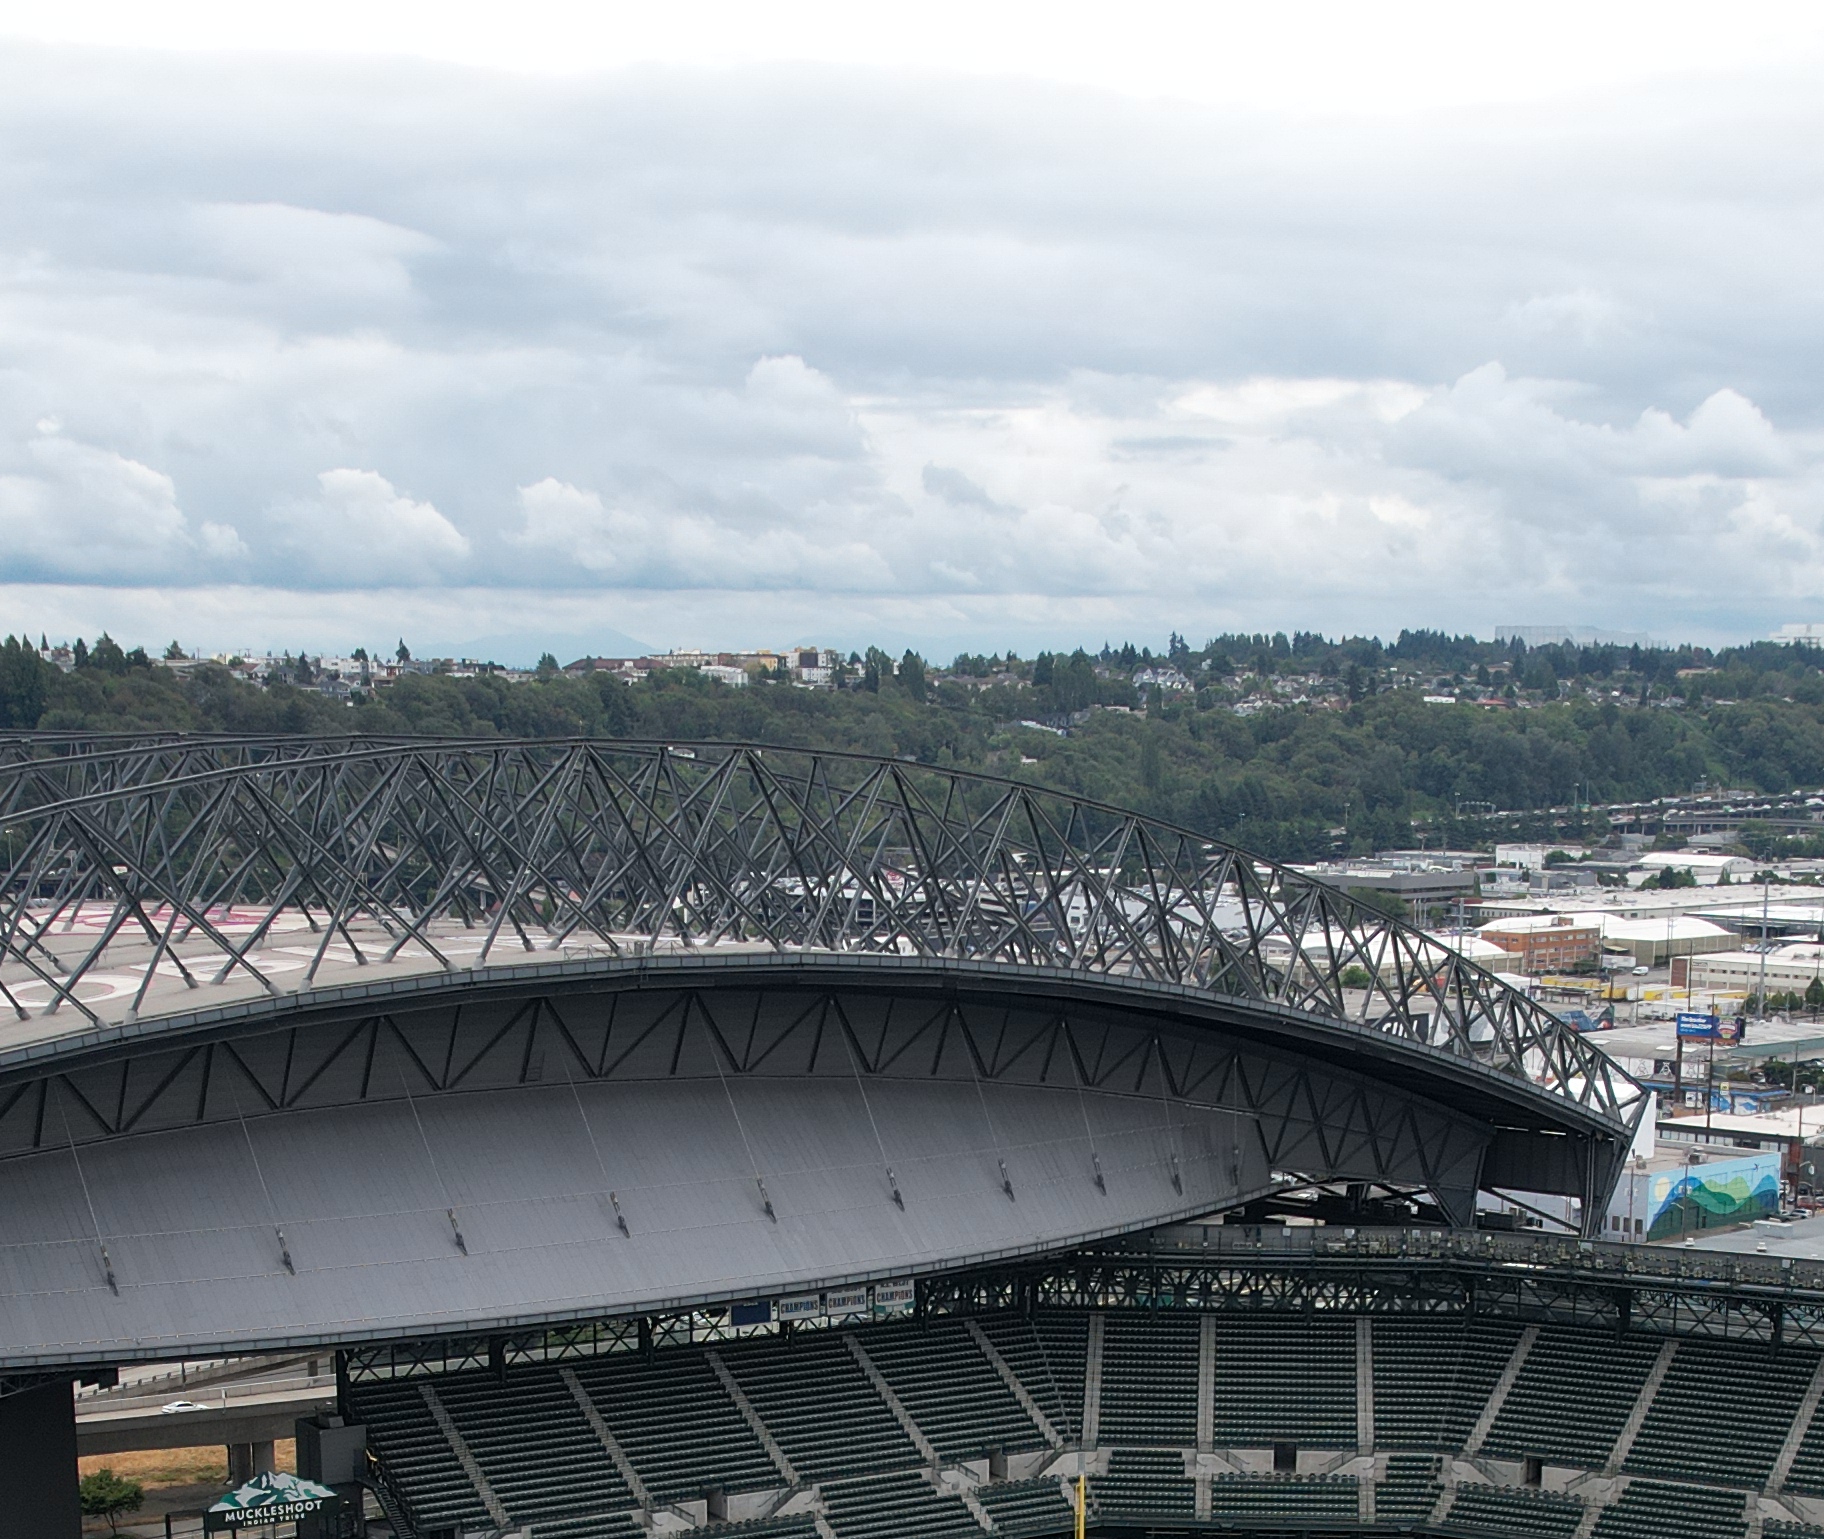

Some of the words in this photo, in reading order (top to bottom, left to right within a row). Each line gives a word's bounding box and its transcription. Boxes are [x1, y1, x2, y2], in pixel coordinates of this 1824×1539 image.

[225, 1500, 323, 1522] MUCKLESHOOT
[243, 1518, 275, 1527] INDIAN
[279, 1513, 305, 1522] TRIBE
